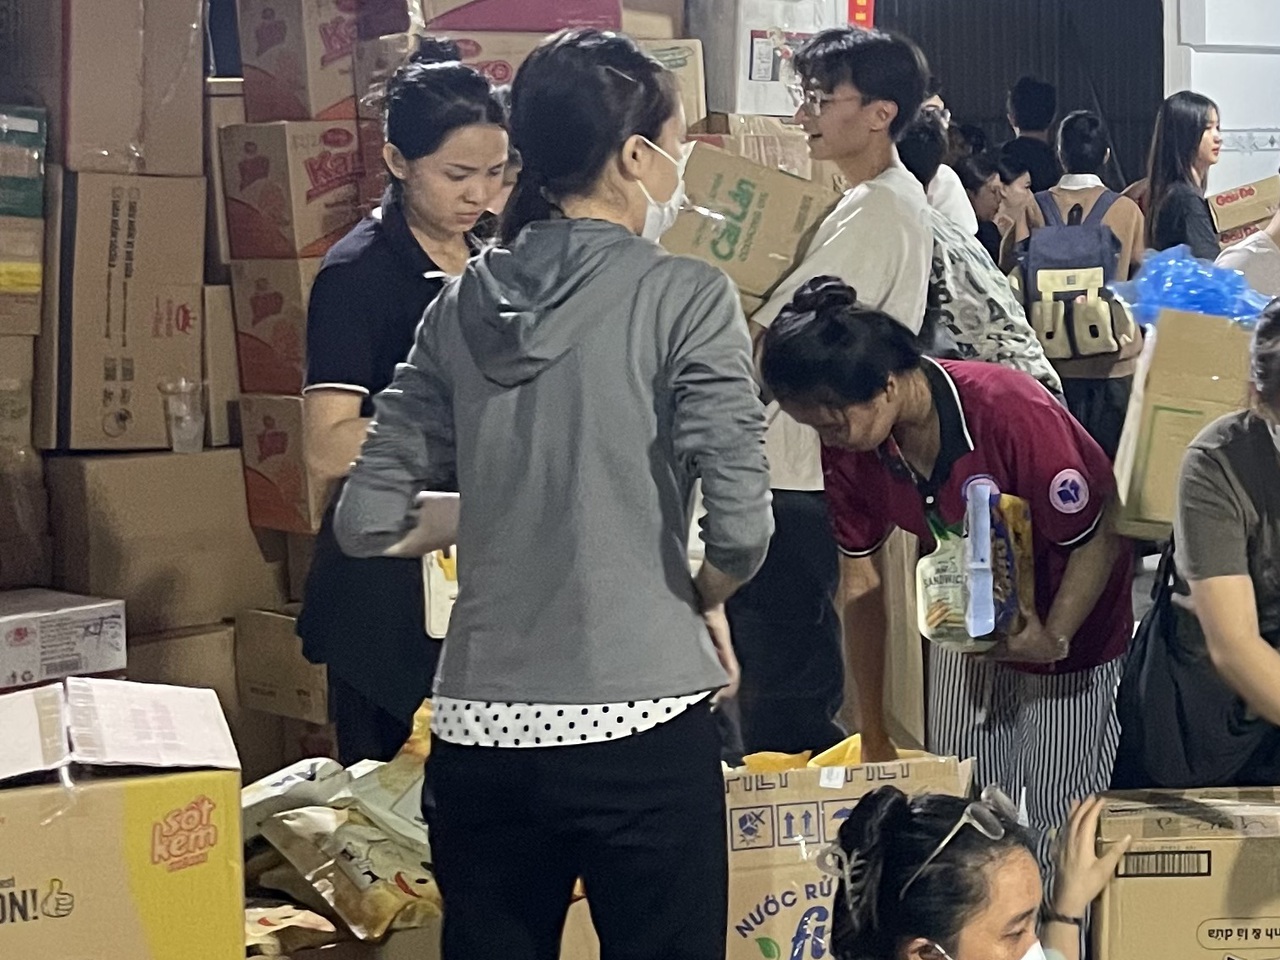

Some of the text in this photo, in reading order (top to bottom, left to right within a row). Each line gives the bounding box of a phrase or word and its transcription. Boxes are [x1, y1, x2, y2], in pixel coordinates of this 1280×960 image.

[152, 826, 217, 866] kem
[805, 875, 834, 900] RỬ
[1207, 928, 1234, 942] dứa
[1236, 928, 1249, 942] lá
[1251, 928, 1262, 939] &
